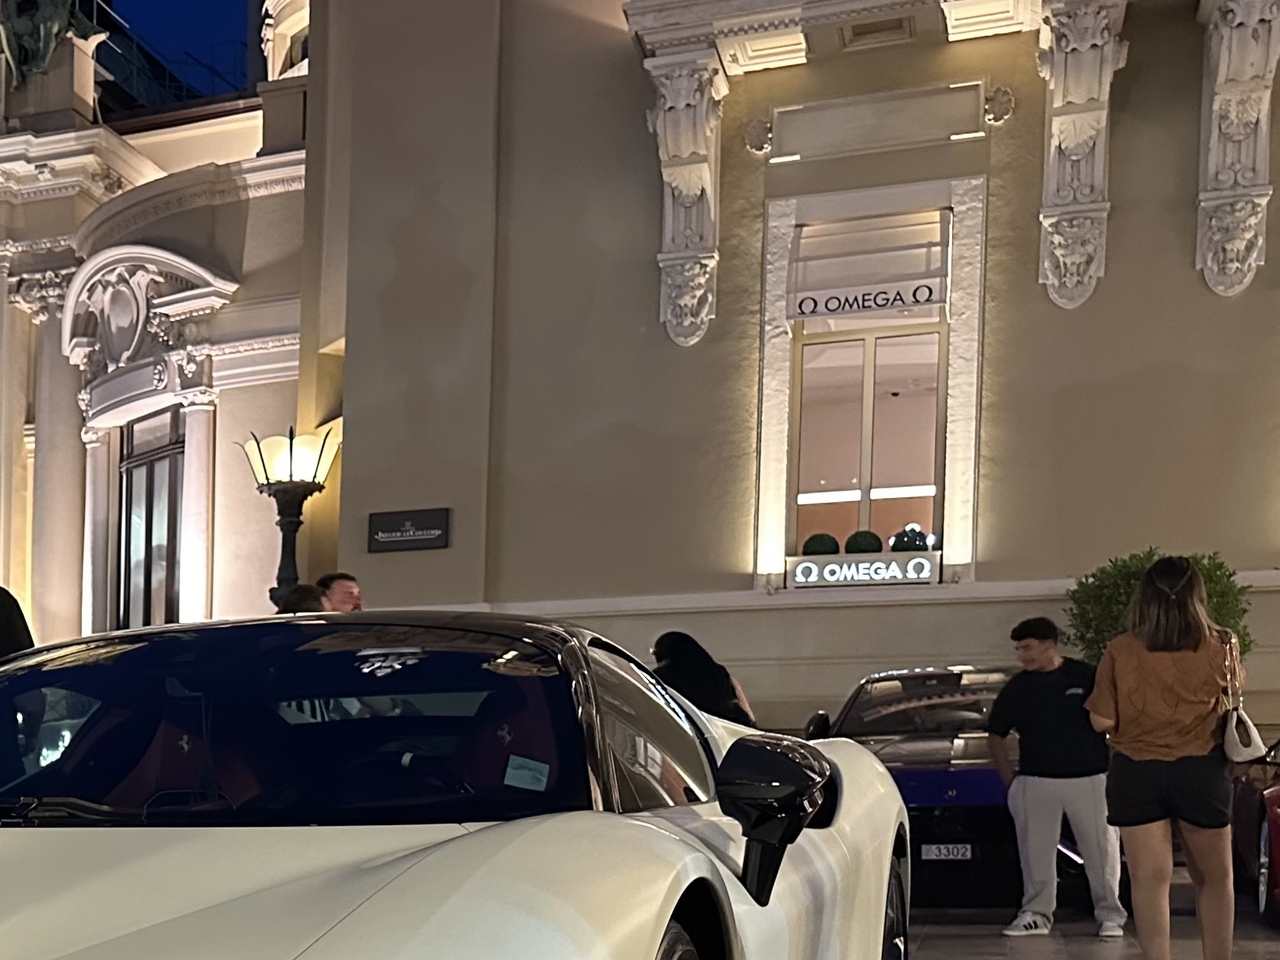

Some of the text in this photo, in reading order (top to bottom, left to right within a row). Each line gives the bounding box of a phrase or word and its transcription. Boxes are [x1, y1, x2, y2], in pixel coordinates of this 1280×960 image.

[825, 290, 905, 313] OMEGA
[823, 561, 903, 582] OMEGA
[934, 845, 969, 858] 3302
